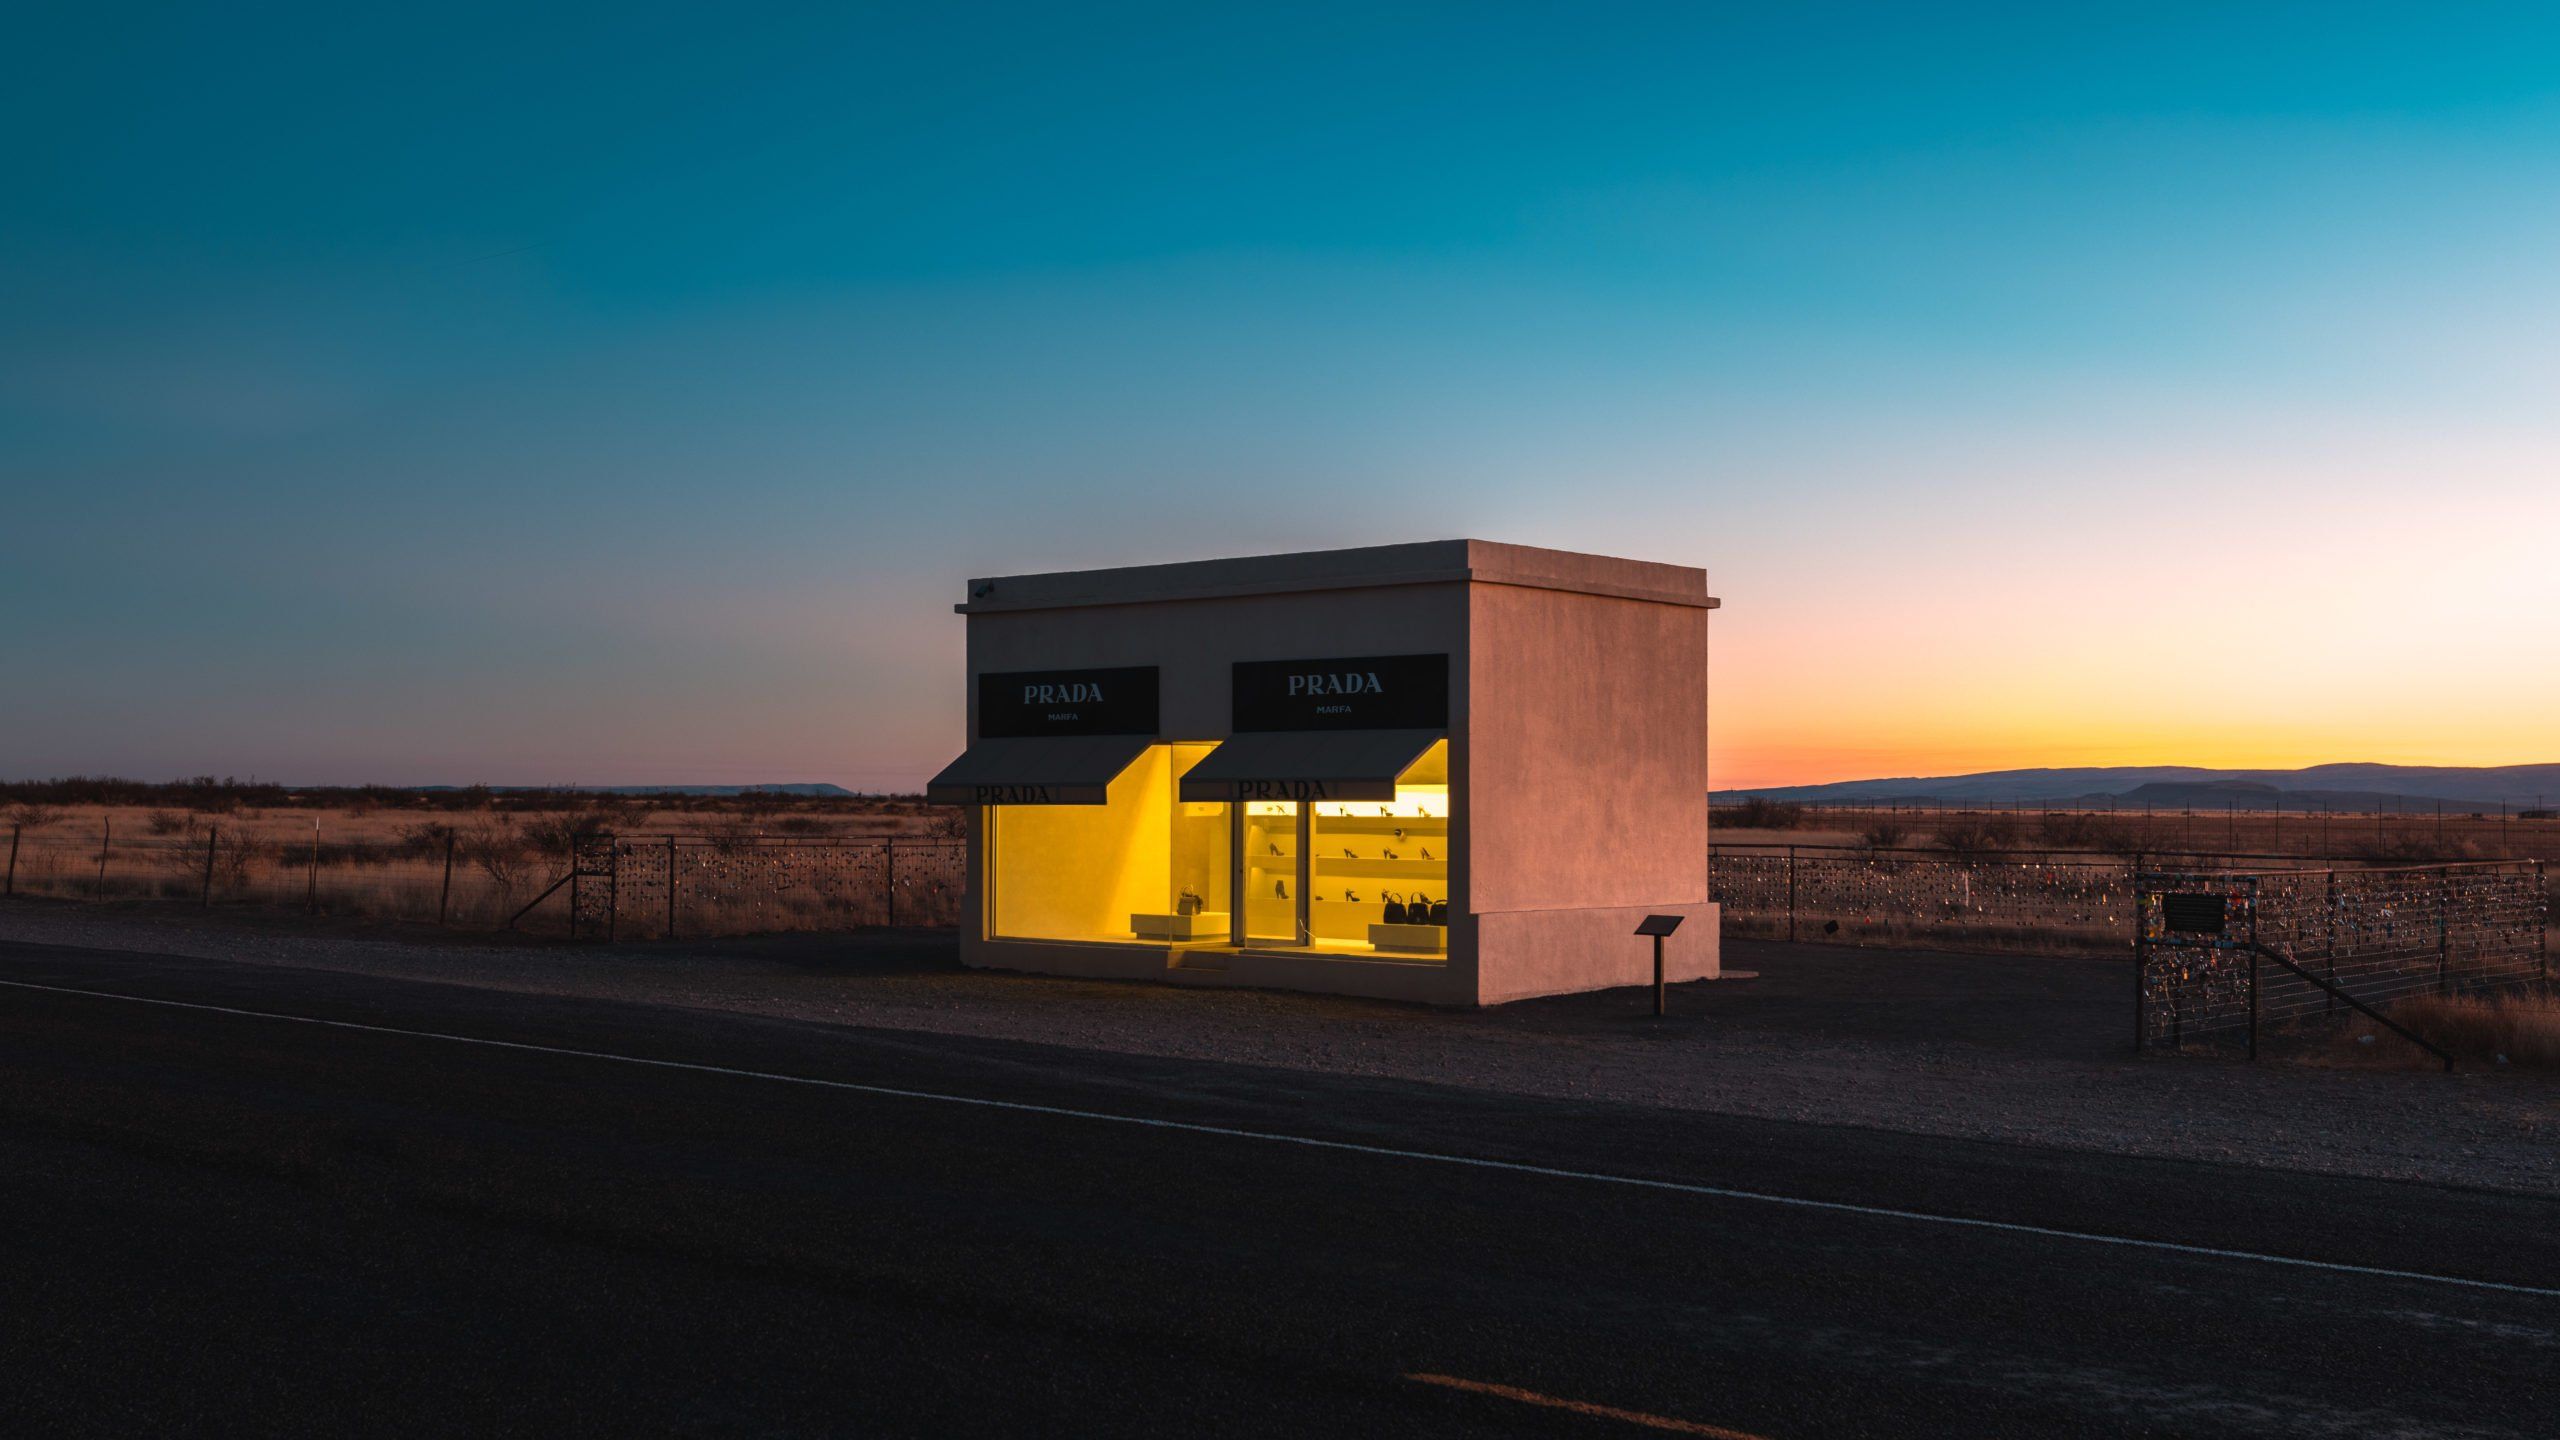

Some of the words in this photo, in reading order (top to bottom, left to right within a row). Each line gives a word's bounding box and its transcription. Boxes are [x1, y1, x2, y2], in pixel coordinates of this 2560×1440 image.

[1288, 672, 1384, 696] PRADA
[1024, 683, 1104, 704] PRADA
[1316, 705, 1352, 714] MARFA
[976, 785, 1050, 803] PRADA
[1239, 781, 1327, 799] PRADA
